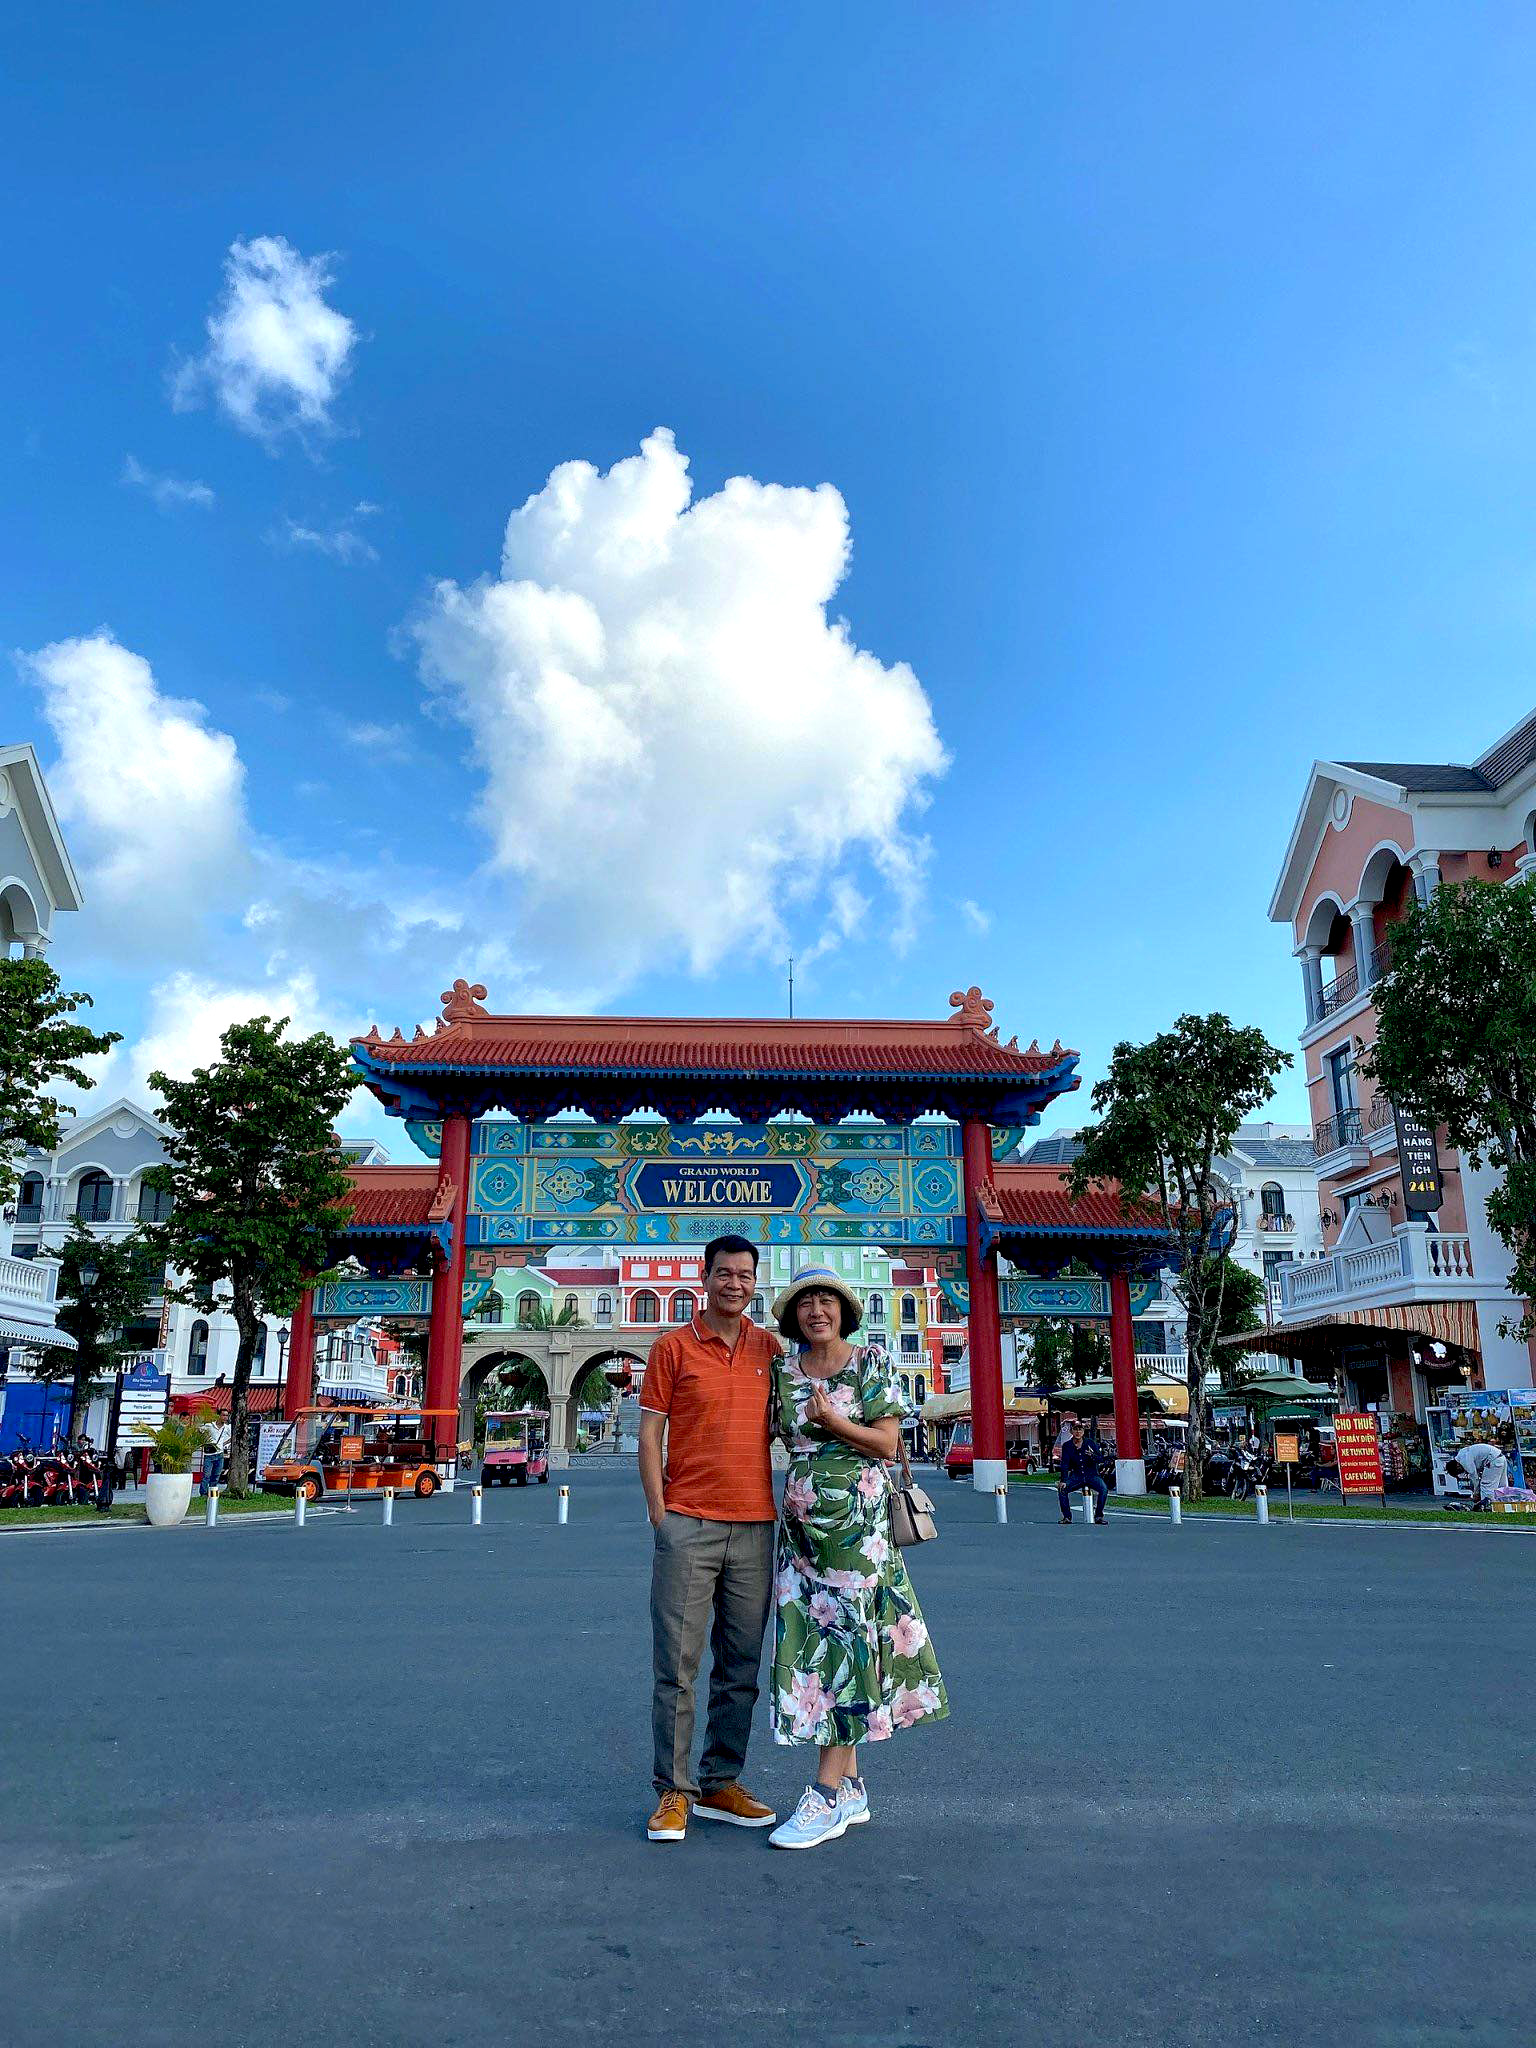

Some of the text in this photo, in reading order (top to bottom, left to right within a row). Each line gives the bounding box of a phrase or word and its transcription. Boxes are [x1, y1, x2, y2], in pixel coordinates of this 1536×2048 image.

[679, 1167, 760, 1176] GRAND WORLD
[1411, 1162, 1431, 1175] ÍCH
[1409, 1181, 1435, 1191] 24H
[662, 1179, 773, 1203] WELCOME
[1335, 1415, 1375, 1430] CHO THUÊ
[1338, 1435, 1346, 1443] XE
[1346, 1434, 1360, 1443] MÁY
[1341, 1447, 1375, 1456] XE TUKTUK
[1344, 1472, 1359, 1480] CAFE
